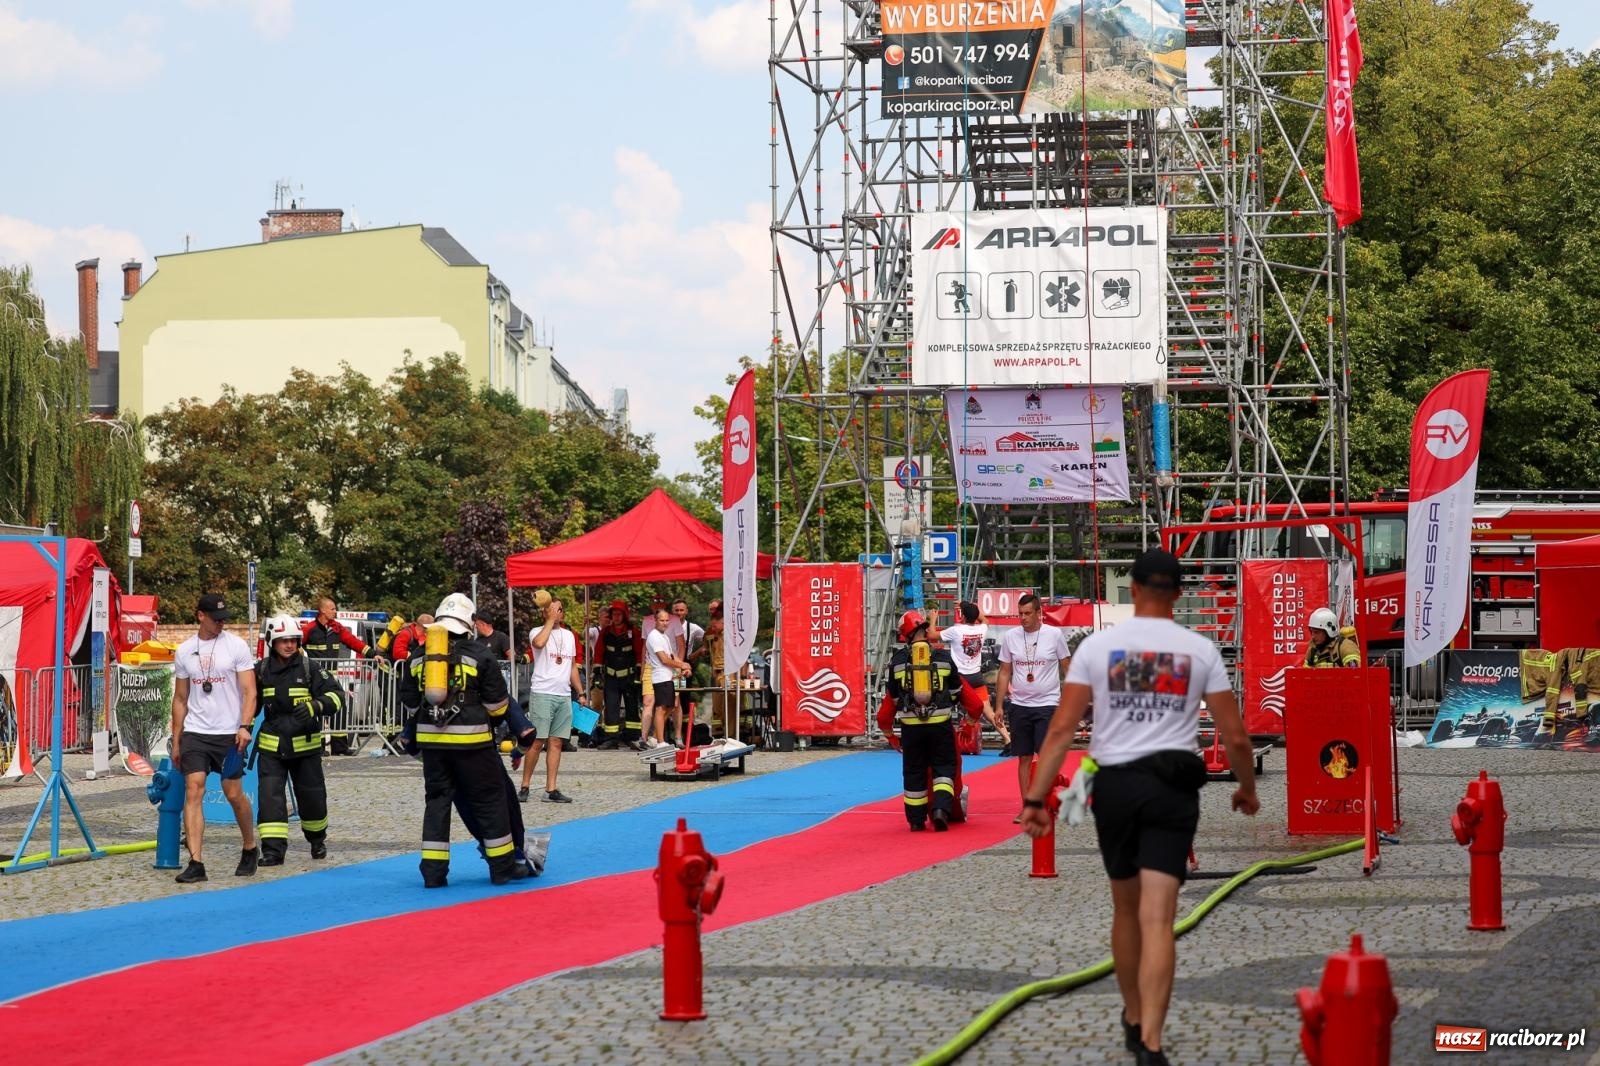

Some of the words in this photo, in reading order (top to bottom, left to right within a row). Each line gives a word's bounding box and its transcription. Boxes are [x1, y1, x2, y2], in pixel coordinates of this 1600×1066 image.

[884, 2, 1046, 29] WYBURZENIA
[910, 46, 943, 65] 501
[952, 44, 988, 64] 747
[993, 43, 1031, 62] 994
[914, 74, 1013, 88] @koparkiraciborz
[886, 98, 1014, 114] koparkiraciborz.pl
[974, 224, 1157, 250] ARPAPOL
[928, 342, 995, 352] KOMPLEKSOWA
[996, 340, 1040, 352] SPRZEDAŻ
[1042, 342, 1082, 353] SPRZĘTU
[1084, 340, 1151, 352] STRAŻACKIEGO
[994, 358, 1082, 368] WWW.ARPAPOL.PL
[1017, 440, 1065, 448] KAMPKA
[1060, 462, 1107, 471] KAREN
[930, 537, 950, 562] P
[736, 508, 744, 646] VANESSA
[1422, 502, 1440, 641] VANESSA
[810, 577, 820, 657] REKORD
[822, 578, 832, 656] RESCUE
[1273, 572, 1284, 654] REKORD
[1286, 573, 1296, 654] RESCUE
[1462, 664, 1521, 682] ostrog.ne
[120, 688, 162, 702] HUSQVARNA
[1110, 695, 1186, 712] CHALLENGE
[1128, 712, 1164, 722] 2017
